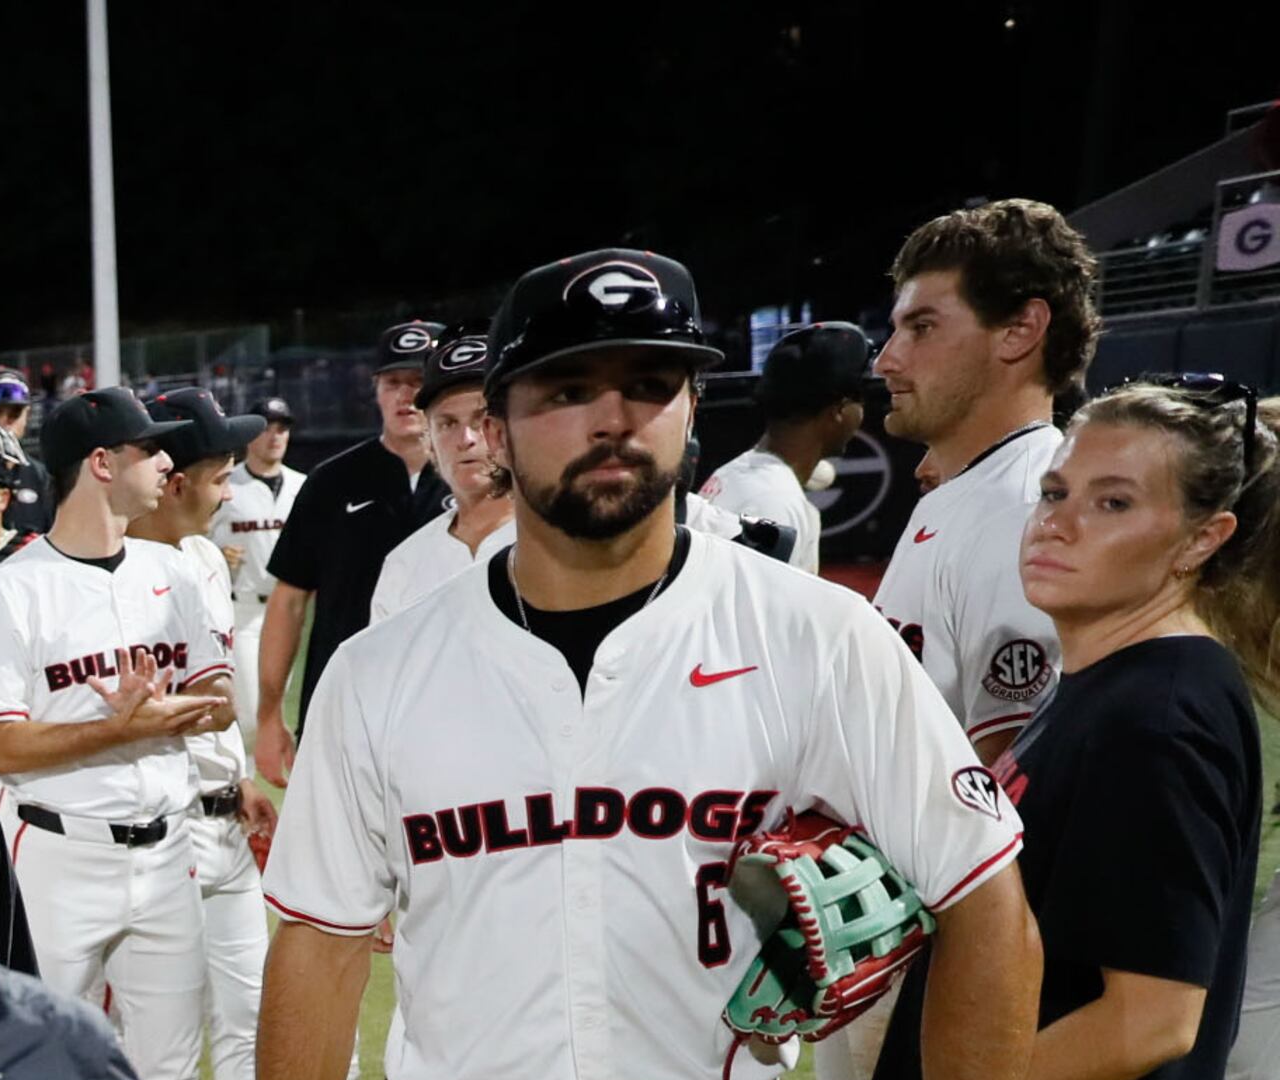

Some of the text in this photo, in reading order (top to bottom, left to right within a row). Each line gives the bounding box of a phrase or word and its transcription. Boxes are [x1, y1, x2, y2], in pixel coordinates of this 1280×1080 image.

[993, 642, 1042, 687] SEC
[404, 786, 780, 864] BULLDOGS
[695, 861, 734, 969] 6
